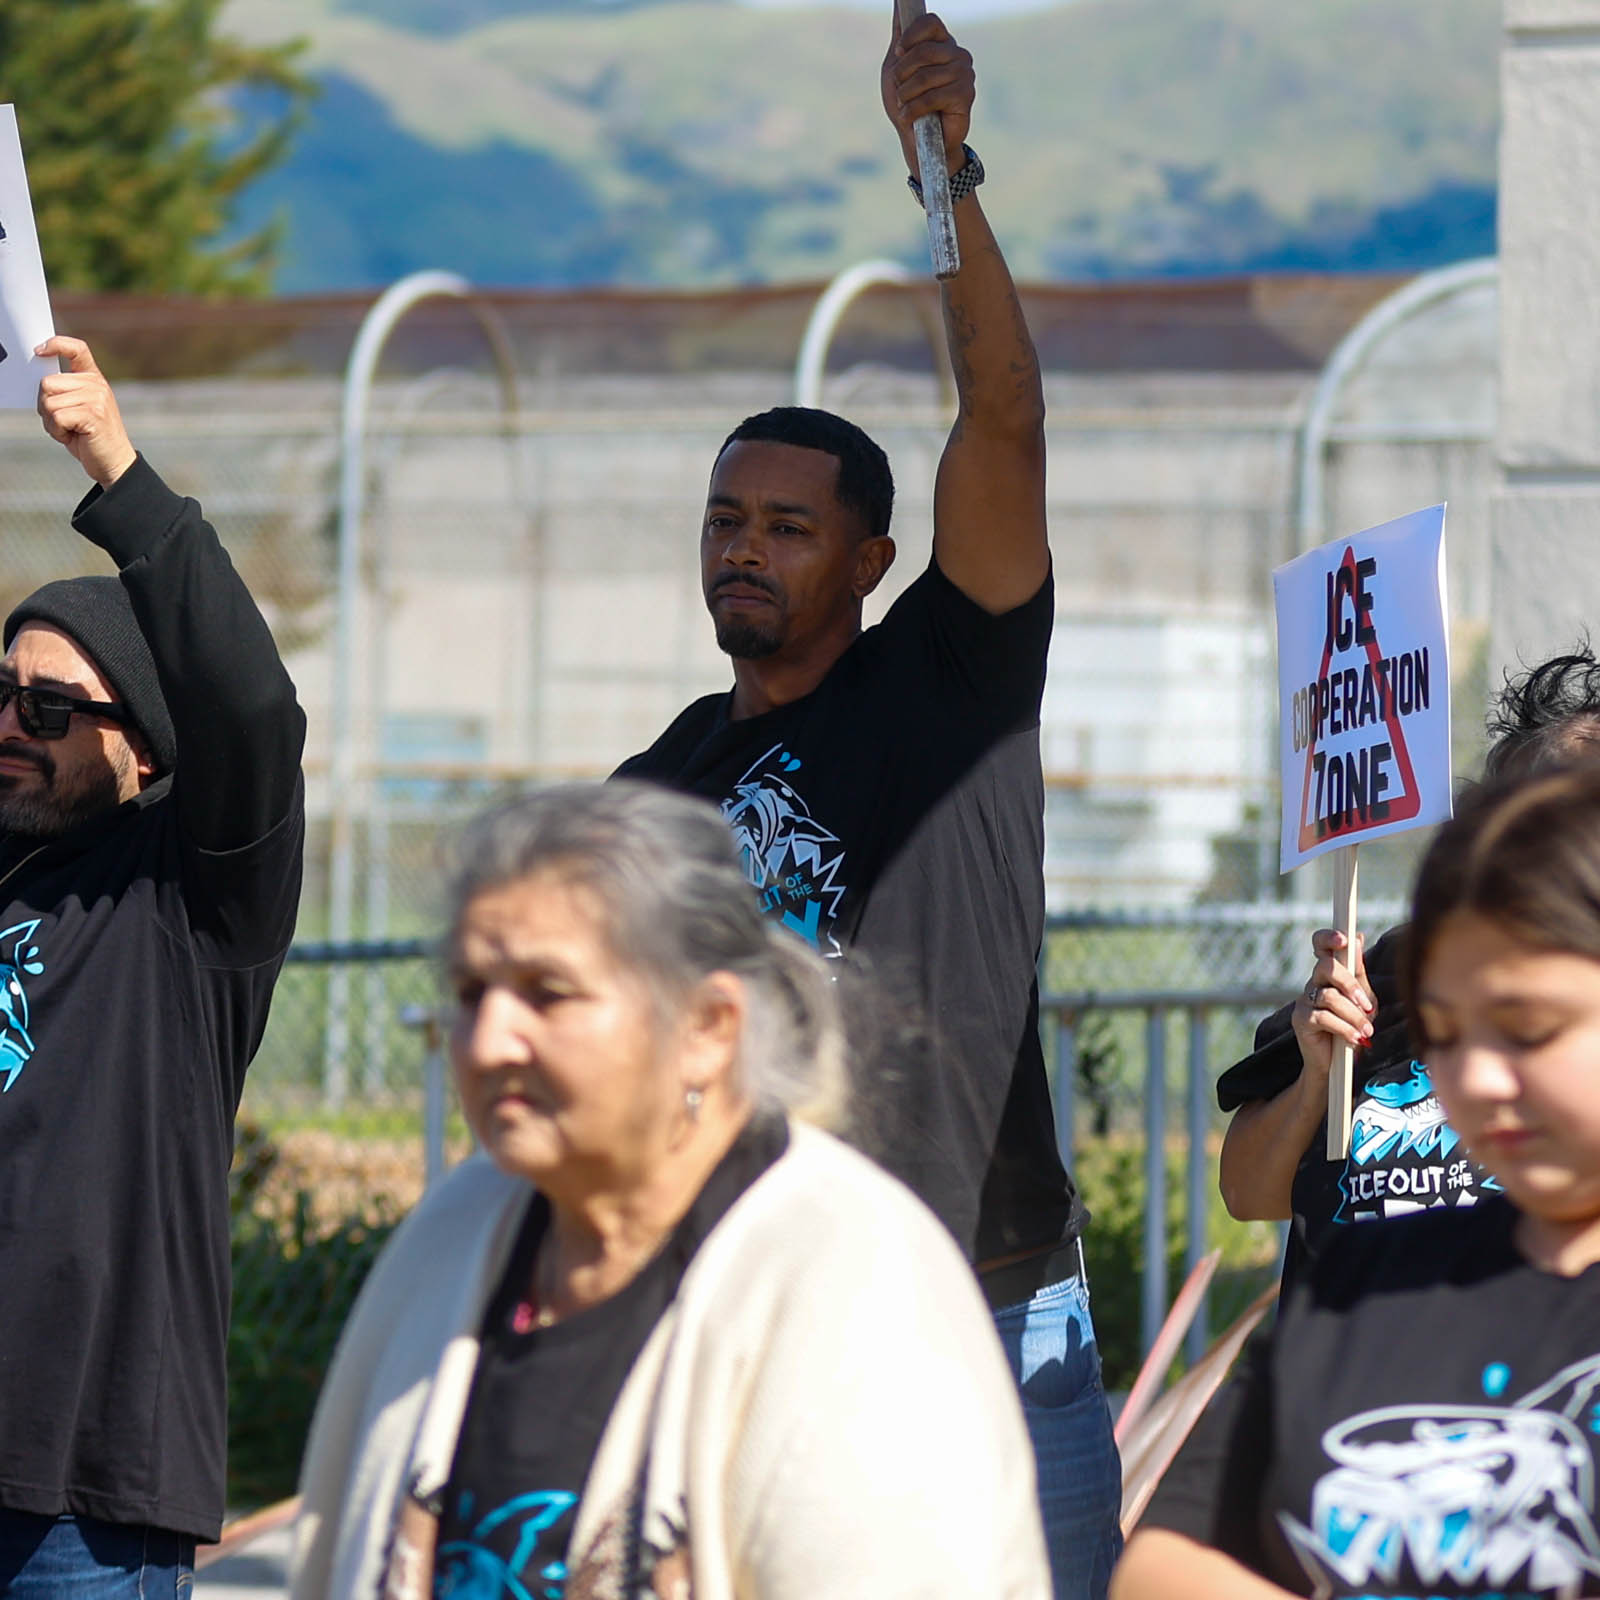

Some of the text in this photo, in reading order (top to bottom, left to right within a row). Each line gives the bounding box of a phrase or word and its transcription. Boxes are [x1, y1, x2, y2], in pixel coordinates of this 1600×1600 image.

[1326, 557, 1377, 657] ICE
[1291, 646, 1430, 753] COOPERATION
[1312, 742, 1393, 839] ZONE
[756, 884, 782, 912] UT
[787, 882, 814, 901] THE
[1447, 1173, 1474, 1190] THE
[1448, 1160, 1468, 1176] OF
[1349, 1166, 1445, 1204] ICE OUT
